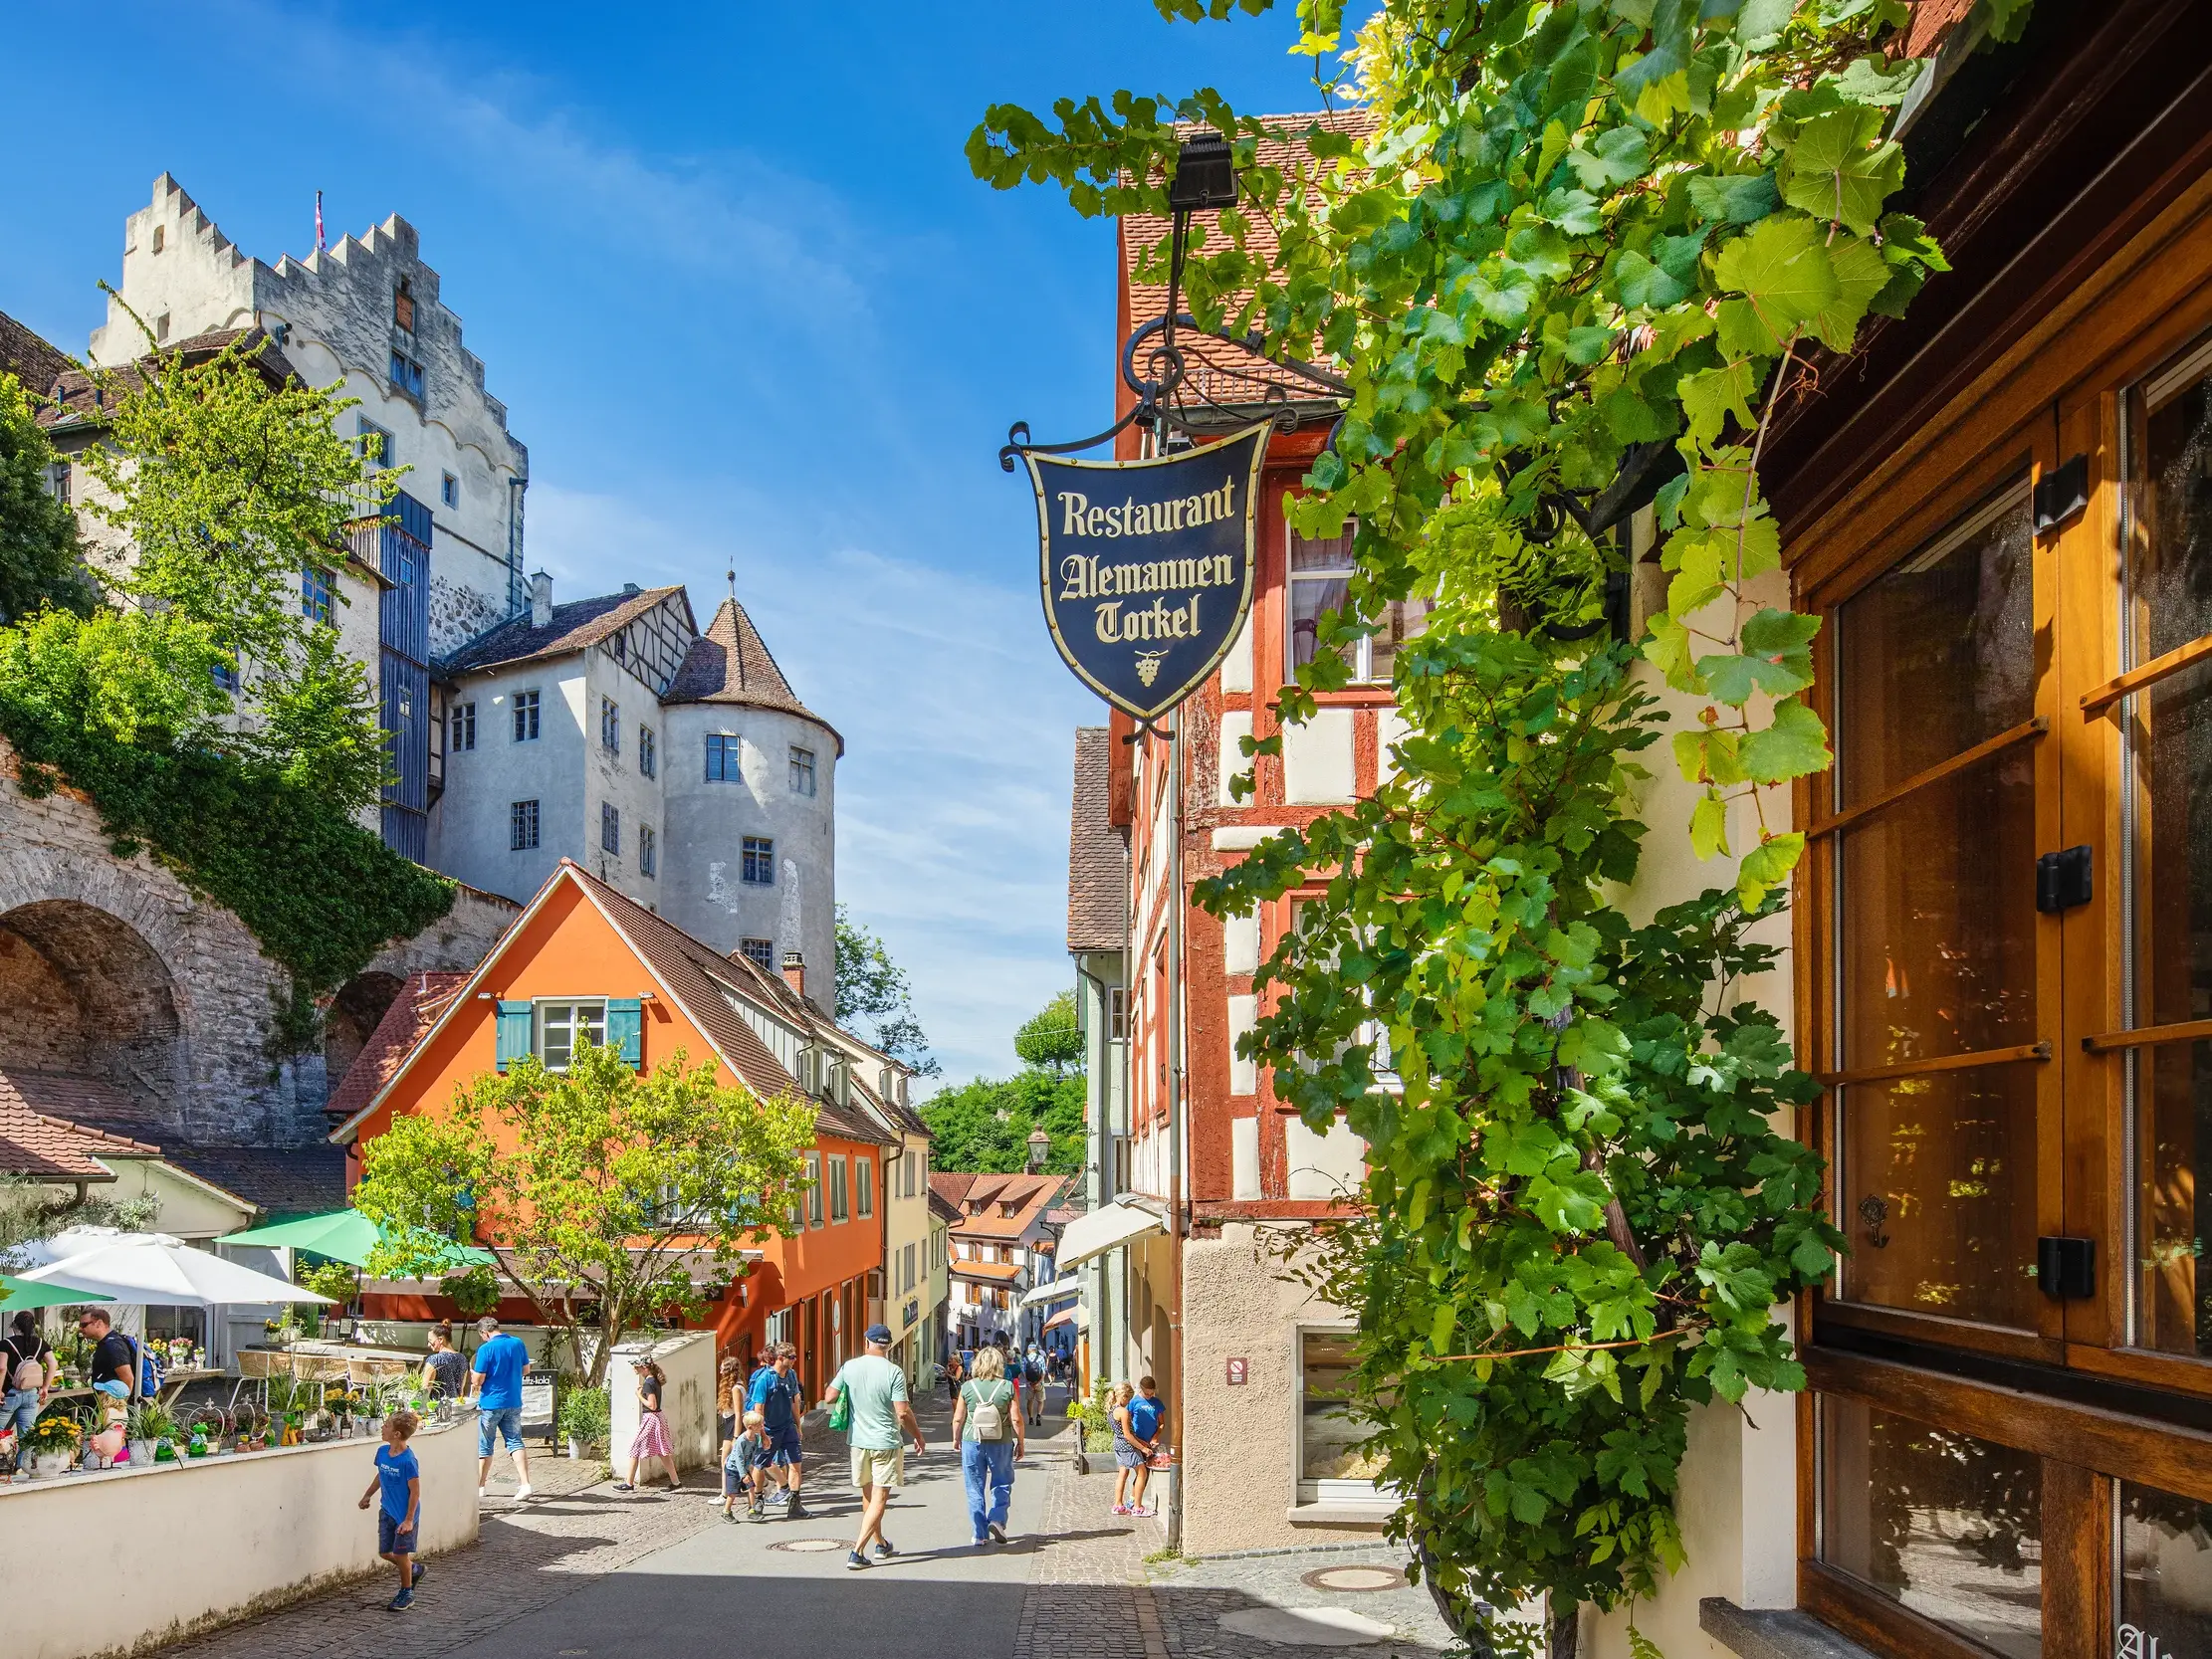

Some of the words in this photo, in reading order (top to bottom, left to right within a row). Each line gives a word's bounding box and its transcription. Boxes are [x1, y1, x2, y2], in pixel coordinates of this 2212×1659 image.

[1057, 475, 1235, 538] Restaurant
[1059, 553, 1236, 602] Alemannen
[1094, 593, 1203, 644] Torkel
[2116, 1623, 2174, 1659] Al
